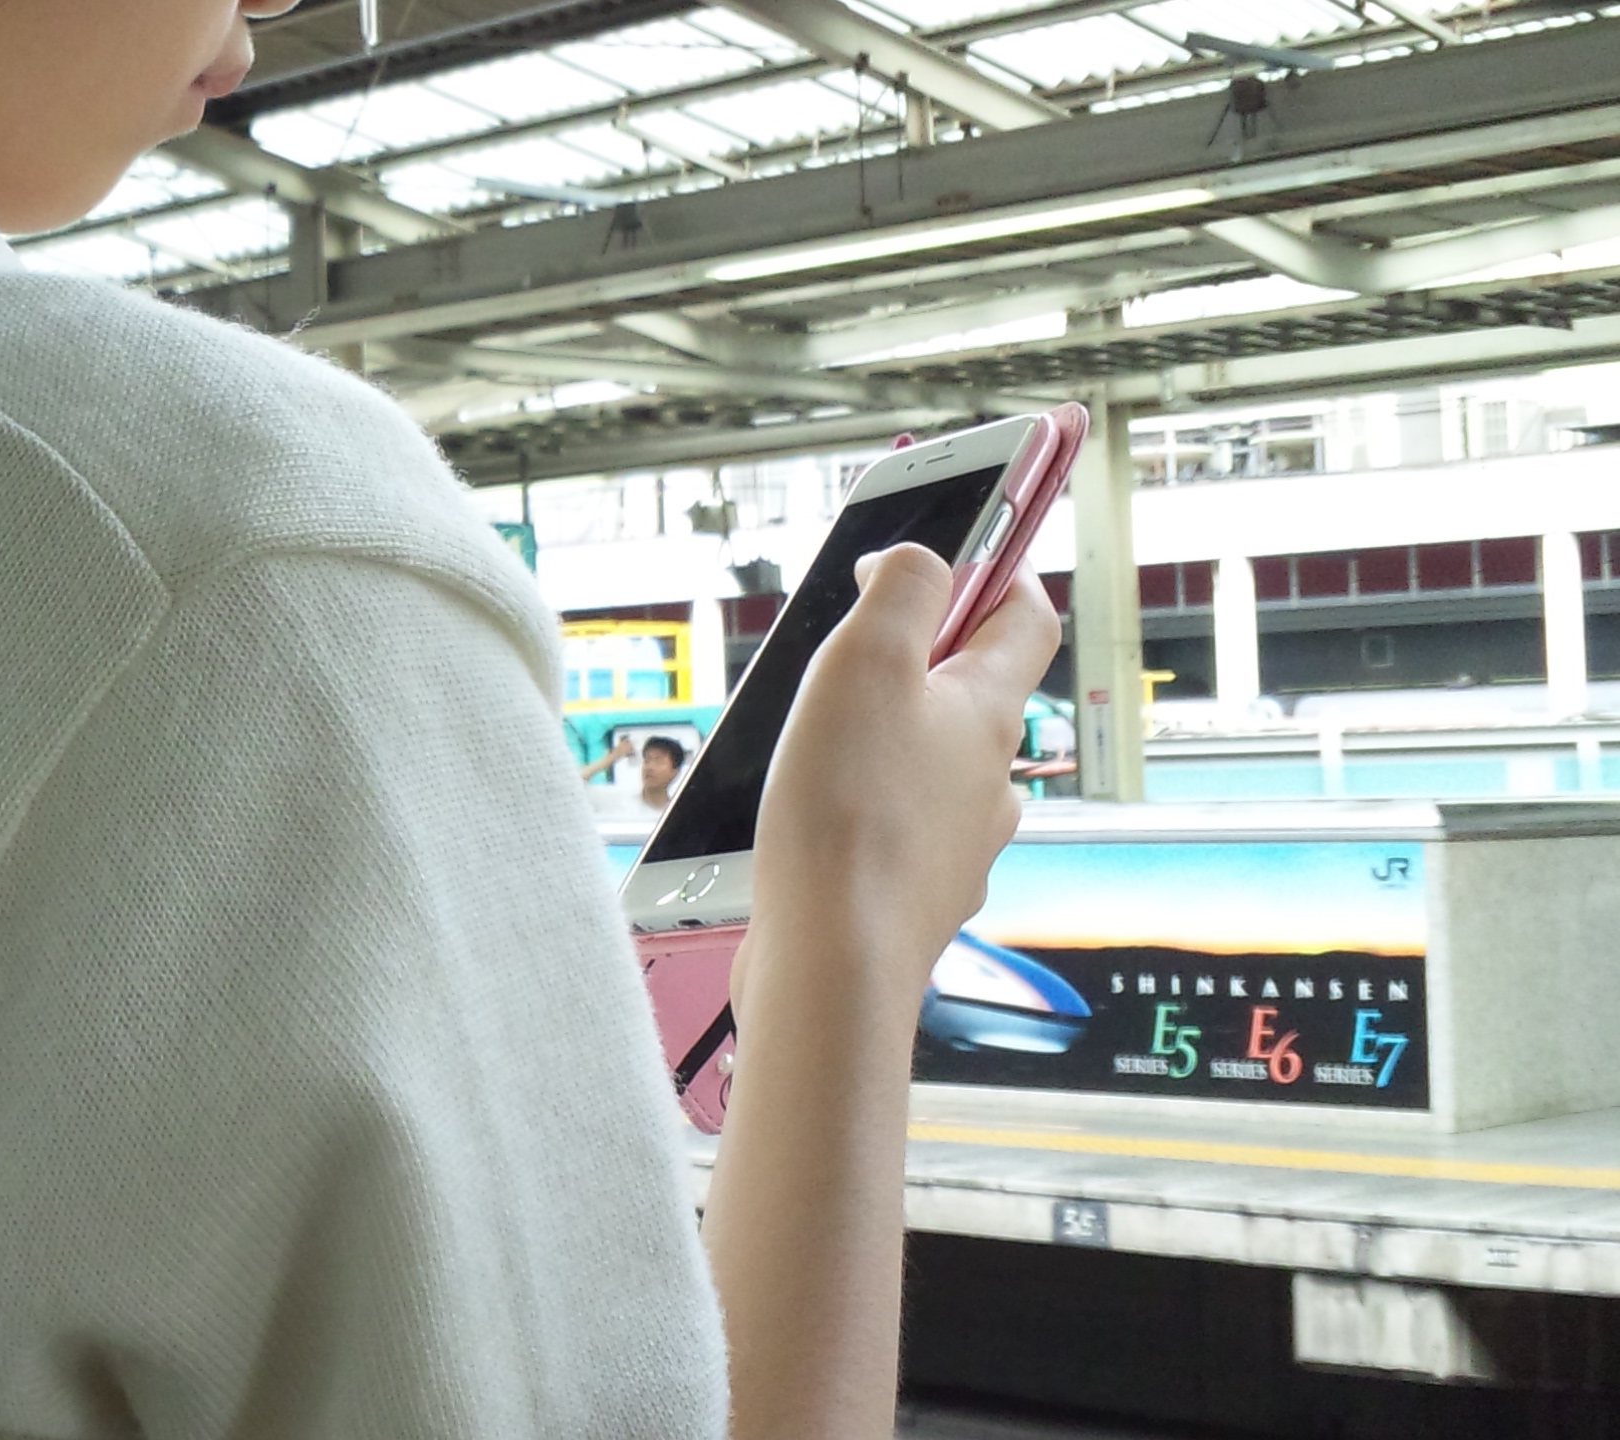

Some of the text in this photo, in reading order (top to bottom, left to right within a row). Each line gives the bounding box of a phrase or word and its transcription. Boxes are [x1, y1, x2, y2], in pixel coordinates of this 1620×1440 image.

[1371, 857, 1409, 881] JR
[1110, 971, 1409, 1001] SHINKANSEN
[1150, 1002, 1409, 1088] E5 E6 E7
